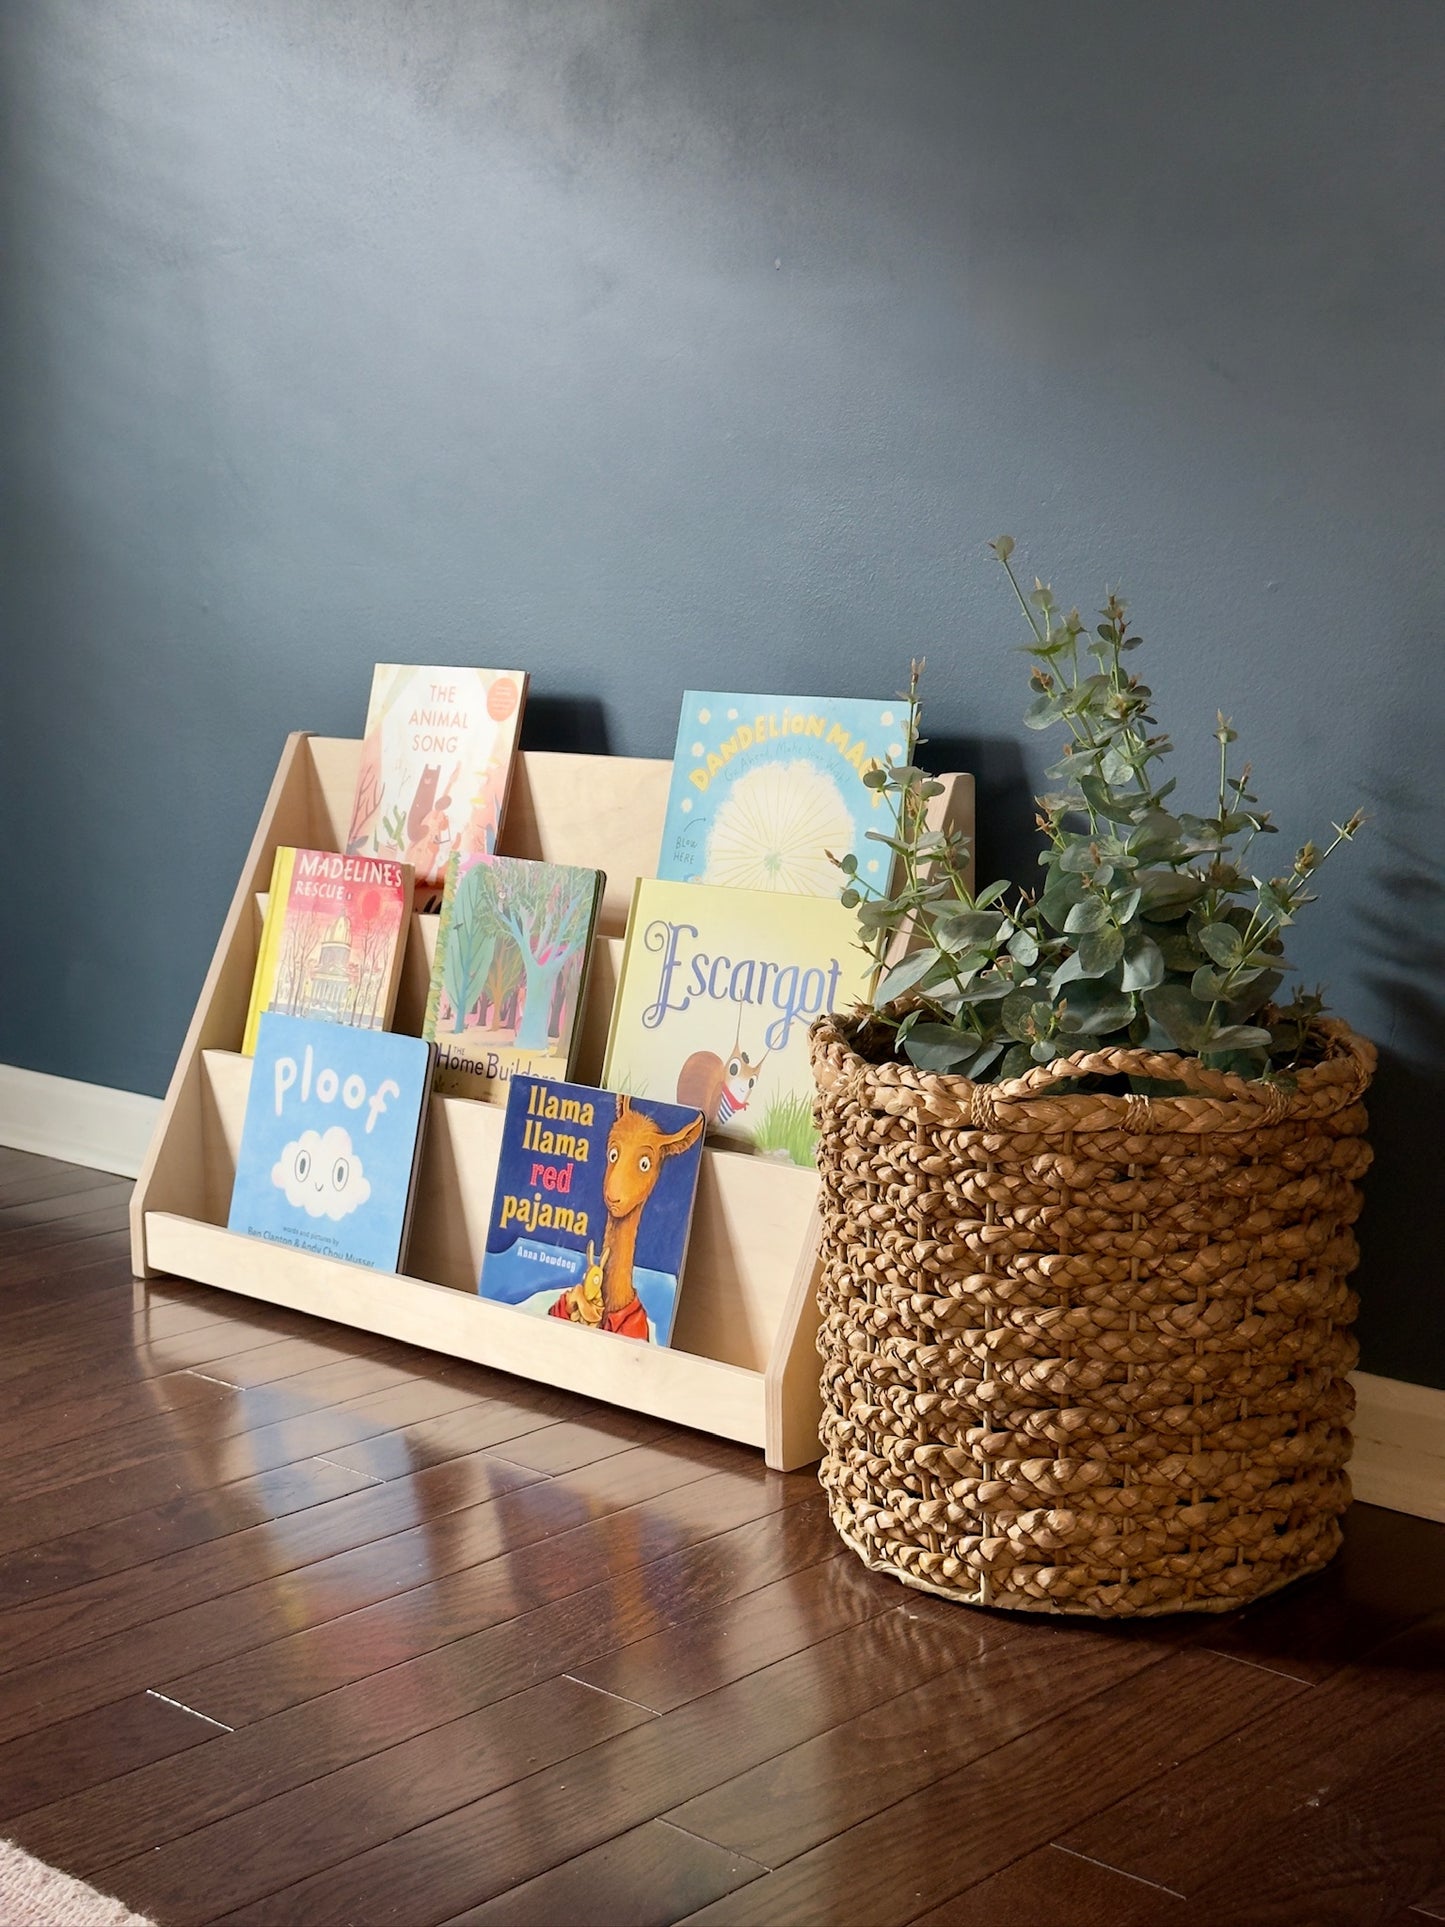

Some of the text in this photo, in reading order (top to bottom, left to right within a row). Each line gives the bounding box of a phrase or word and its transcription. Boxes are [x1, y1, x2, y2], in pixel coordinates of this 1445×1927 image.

[429, 684, 457, 704] THE
[408, 709, 469, 729] ANIMAL
[411, 734, 459, 753] SONG
[688, 707, 827, 793] DANDELION
[673, 851, 695, 865] HERE
[294, 880, 346, 900] RESCUE
[642, 920, 843, 1051] Escargot
[436, 1042, 485, 1076] Home
[453, 1046, 466, 1056] THE
[274, 1043, 401, 1135] ploof
[527, 1084, 595, 1127] llama
[522, 1119, 590, 1163] llama
[529, 1162, 575, 1194] red
[499, 1192, 589, 1237] pajama
[247, 1226, 262, 1237] Ben
[263, 1230, 293, 1246] Clanton
[294, 1238, 300, 1248] &
[517, 1245, 576, 1273] Anna Dewdney
